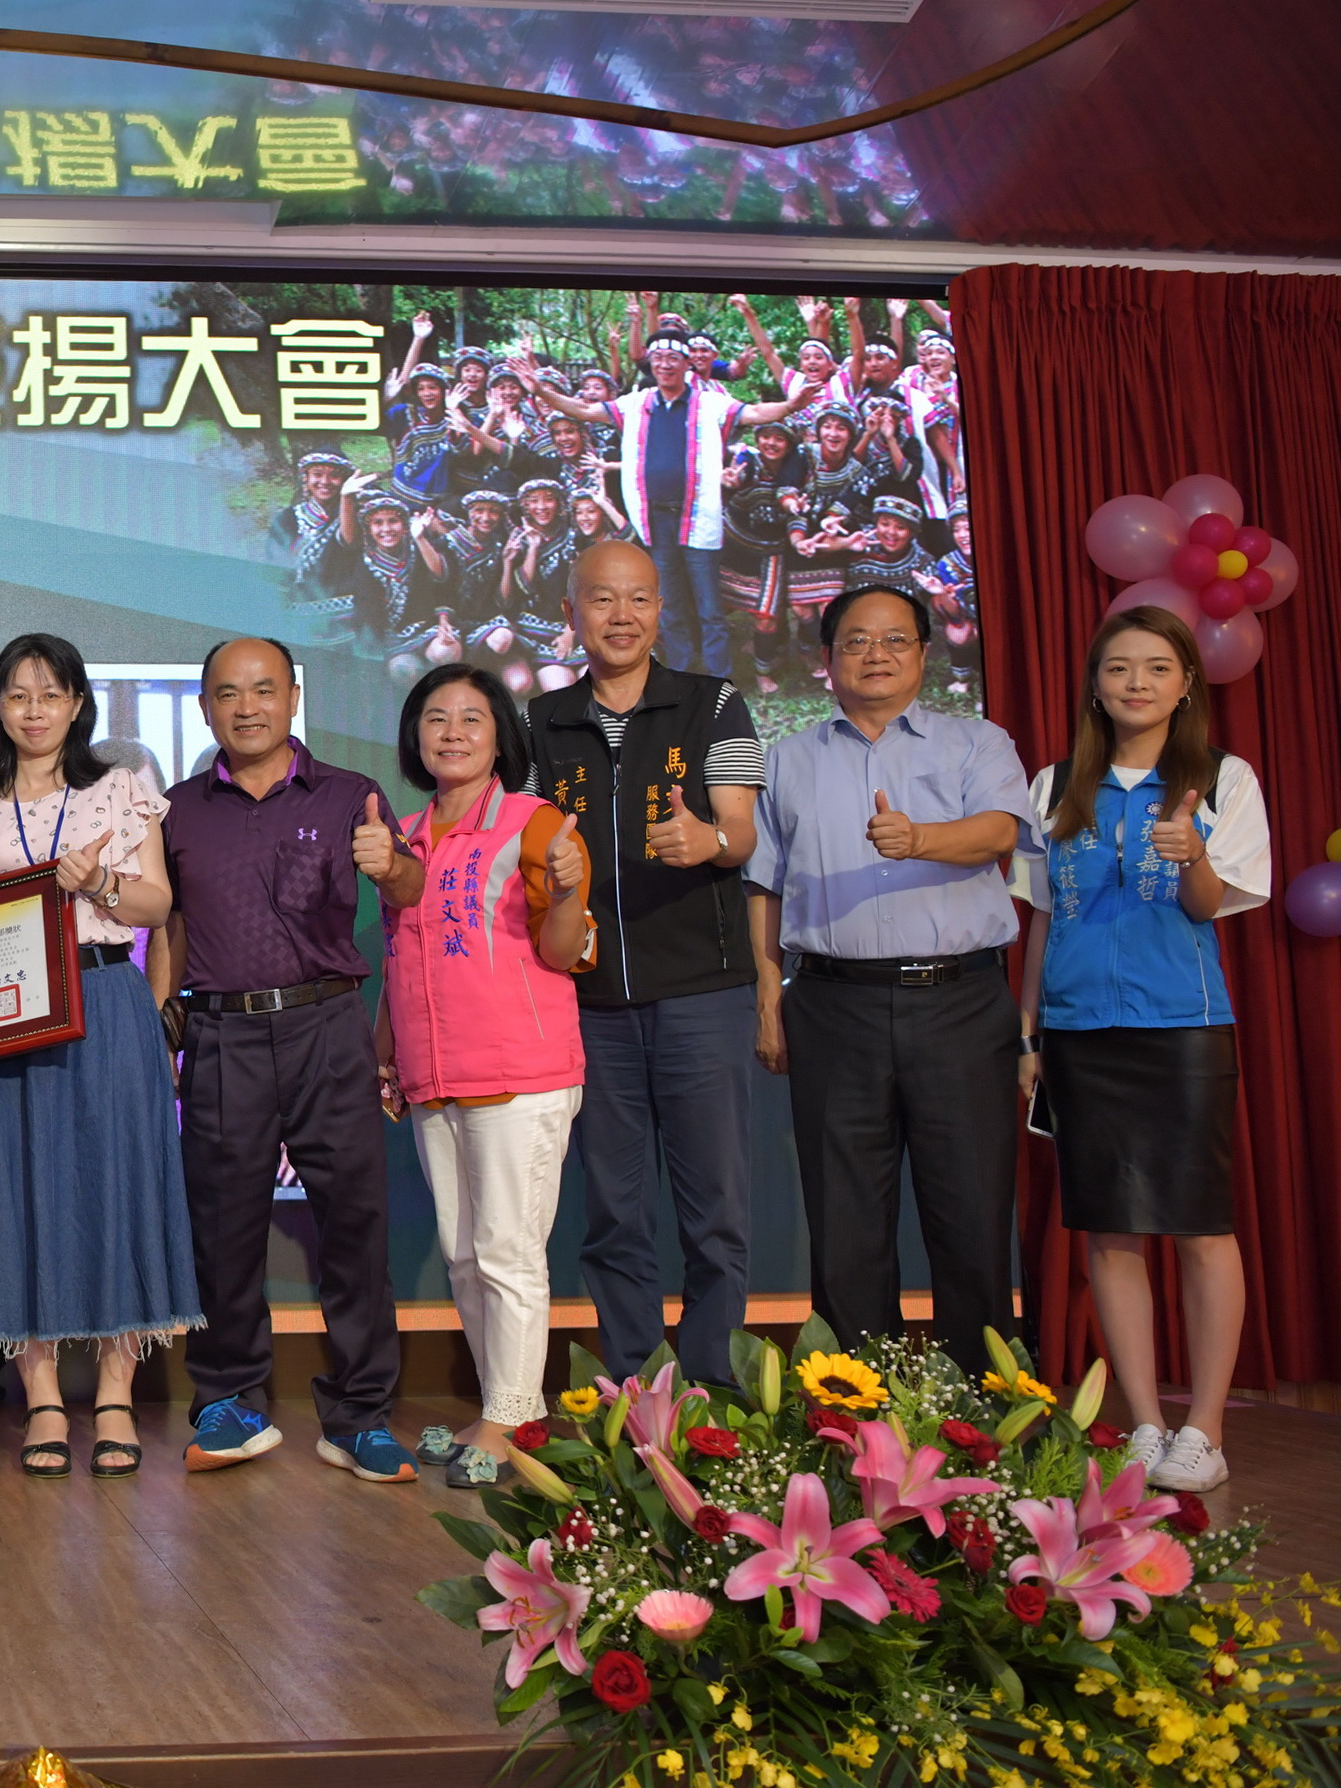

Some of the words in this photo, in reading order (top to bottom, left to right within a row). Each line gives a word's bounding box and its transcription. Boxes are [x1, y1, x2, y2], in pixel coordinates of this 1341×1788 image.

[574, 766, 587, 812] 主任
[438, 867, 469, 958] 莊文斌
[463, 848, 482, 930] 南投縣議員
